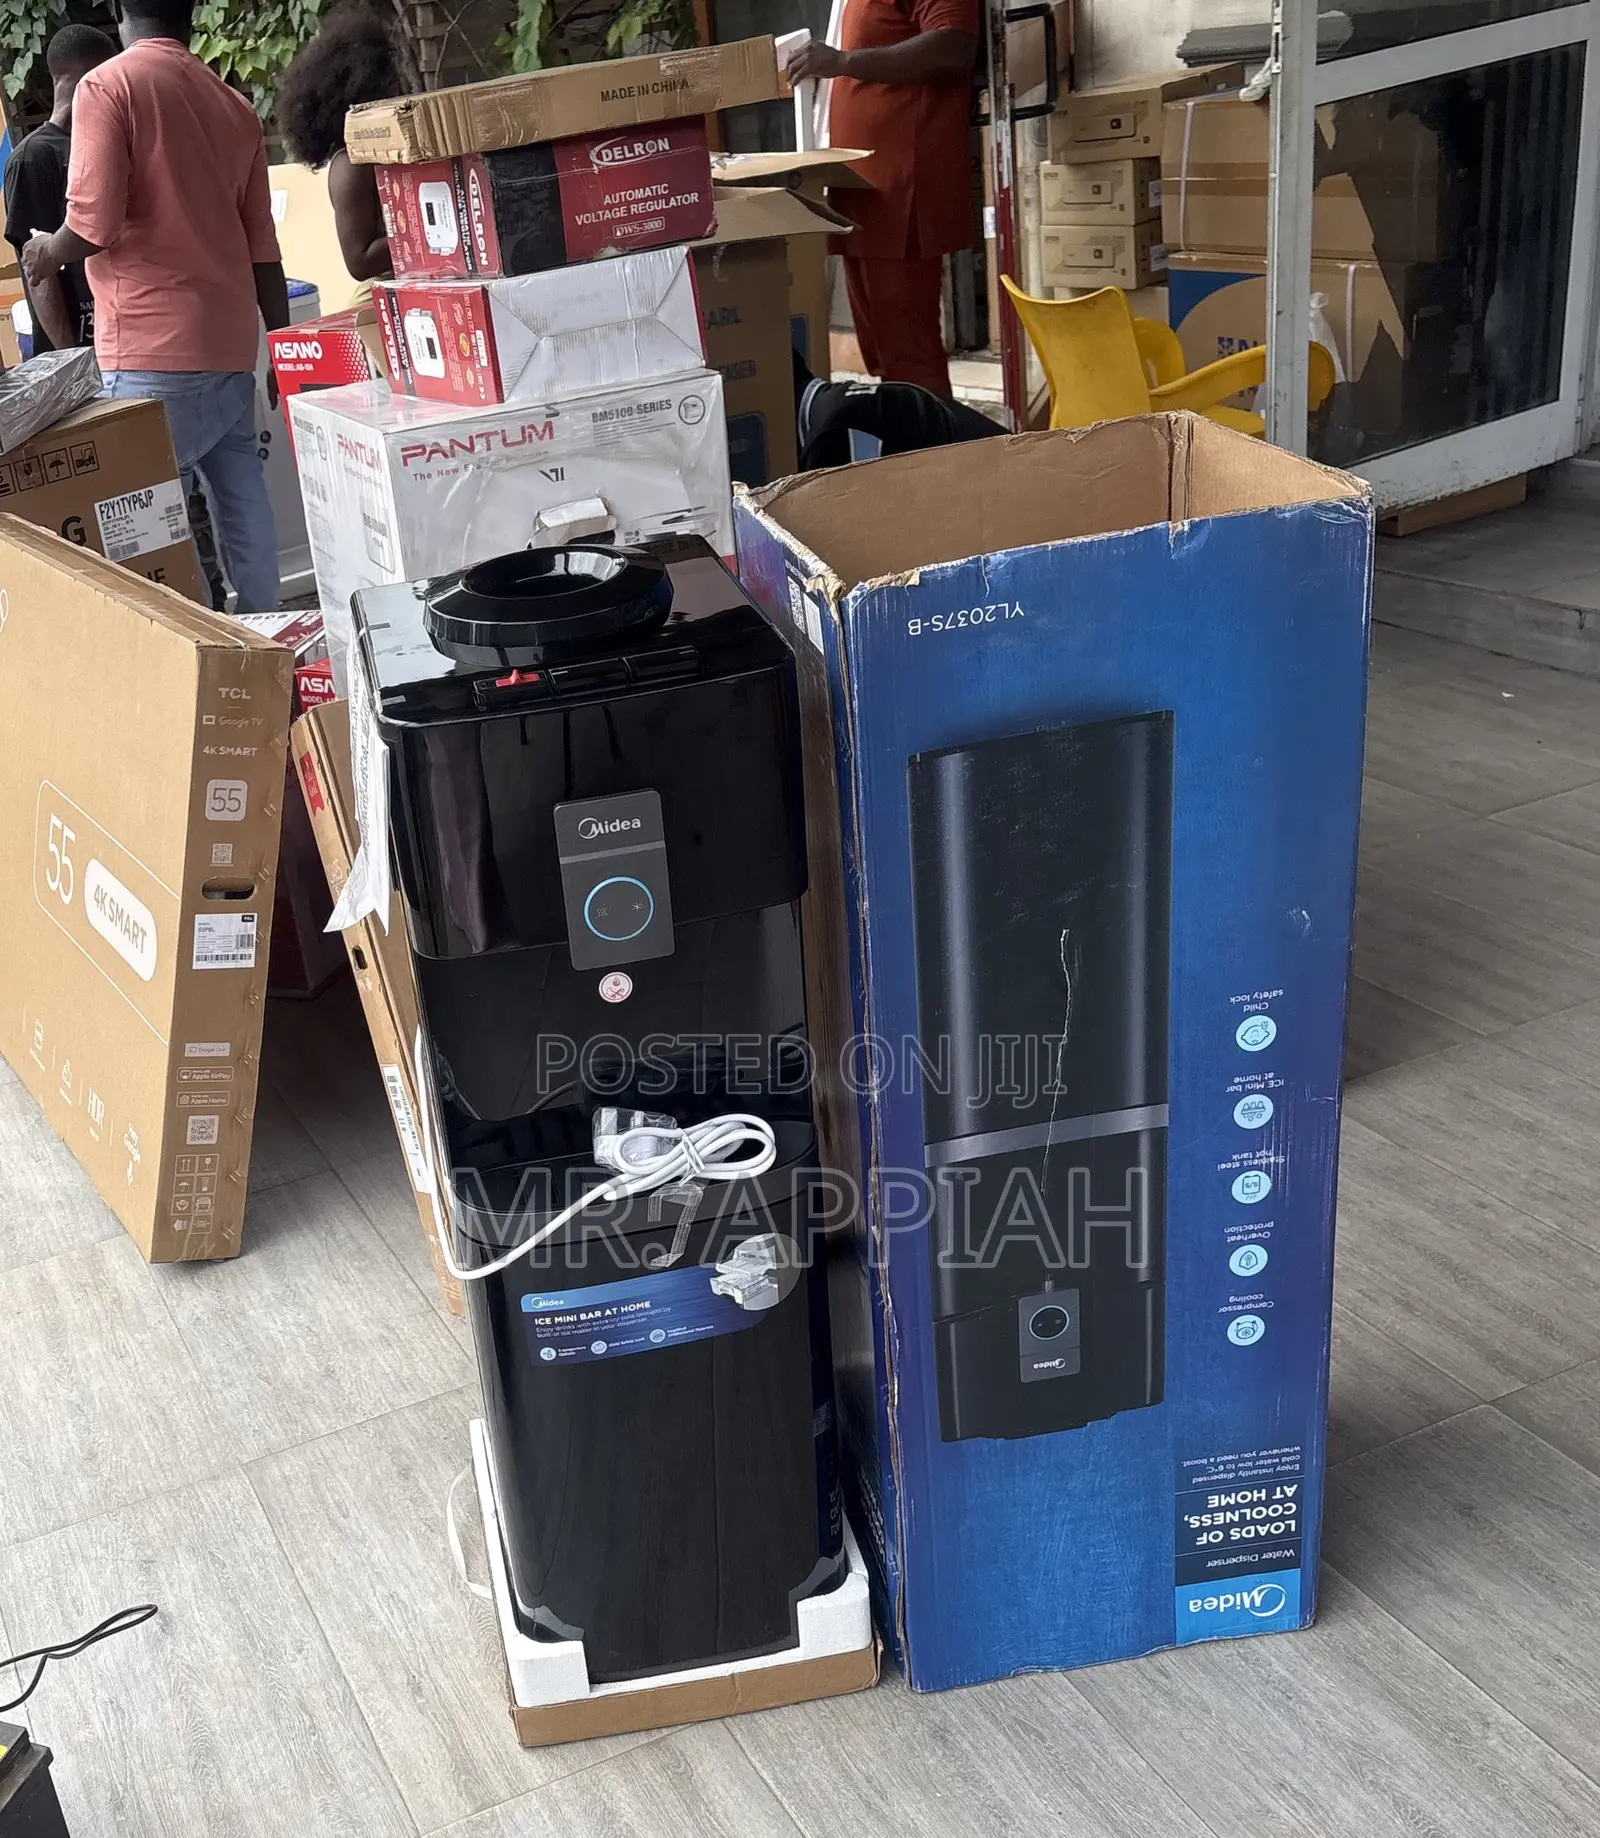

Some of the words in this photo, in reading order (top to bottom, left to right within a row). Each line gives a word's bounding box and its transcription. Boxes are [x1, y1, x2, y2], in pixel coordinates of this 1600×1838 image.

[600, 86, 635, 102] MADE
[637, 84, 650, 97] IN
[651, 78, 690, 94] CHINA
[592, 137, 670, 164] DELRON
[603, 183, 669, 205] AUTOMATIC
[575, 206, 628, 226] VOLTAGE
[630, 192, 699, 215] REGULATOR
[469, 176, 488, 266] DELRON
[274, 340, 323, 359] ASANO
[636, 399, 672, 415] SERIES
[401, 421, 554, 467] PANTUM
[336, 433, 383, 473] PANTUM
[413, 472, 432, 482] The
[98, 489, 155, 521] F2Y1TYP6JP
[61, 516, 87, 546] G
[907, 601, 1025, 636] YL2037S-B
[218, 687, 251, 700] TCL
[218, 715, 249, 728] Google
[250, 717, 264, 728] TV
[211, 787, 242, 813] 55
[578, 817, 641, 840] Midea
[46, 812, 76, 905] 55
[1229, 994, 1250, 1005] lock
[1253, 988, 1284, 1000] safety
[1243, 1002, 1269, 1013] Child
[1233, 1074, 1261, 1084] home
[1267, 1079, 1284, 1088] ICE
[1225, 1083, 1242, 1093] bar
[1245, 1082, 1265, 1091] Mini
[1232, 1151, 1253, 1161] tank
[1255, 1149, 1272, 1158] hot
[1217, 1161, 1240, 1171] steel
[1243, 1155, 1285, 1167] Stainless
[1224, 1220, 1274, 1234] protection
[1226, 1231, 1271, 1243] Overheat
[531, 1296, 565, 1309] Midea
[1229, 1293, 1264, 1302] cooling
[534, 1317, 552, 1325] ICE
[554, 1315, 577, 1324] MINI
[580, 1310, 602, 1320] BAR
[604, 1307, 618, 1316] AT
[621, 1300, 651, 1313] HOME
[1218, 1301, 1275, 1313] Compressor
[1033, 1358, 1066, 1369] Midea
[1259, 1445, 1301, 1456] whenever
[1181, 1458, 1208, 1467] boost.
[1217, 1453, 1239, 1462] need
[1255, 1457, 1280, 1466] water
[1281, 1454, 1301, 1462] cold
[1237, 1467, 1274, 1477] instantly
[1276, 1463, 1300, 1472] Enjoy
[1192, 1472, 1236, 1484] dispensed
[1207, 1488, 1266, 1508] HOME
[1272, 1484, 1298, 1500] AT
[1183, 1502, 1297, 1529] COOLNESS,
[1230, 1519, 1296, 1541] LOADS
[1195, 1530, 1224, 1545] OF
[1206, 1553, 1259, 1568] Dispenser
[1261, 1549, 1295, 1561] Water
[1188, 1583, 1287, 1617] Midea
